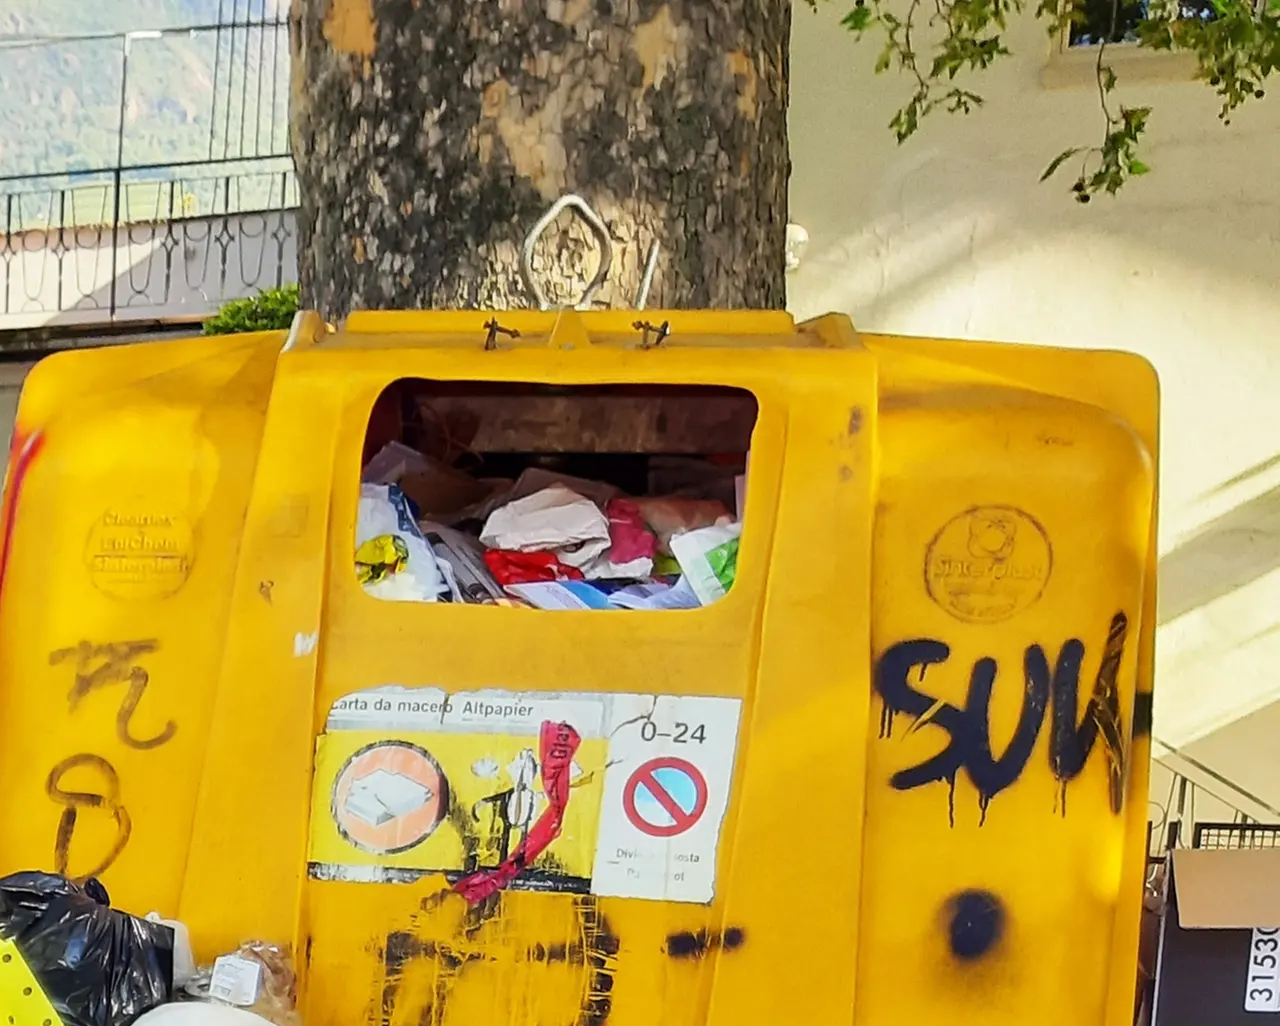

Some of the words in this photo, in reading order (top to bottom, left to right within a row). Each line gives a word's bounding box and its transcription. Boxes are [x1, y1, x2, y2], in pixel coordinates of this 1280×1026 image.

[374, 697, 391, 711] da
[397, 700, 454, 714] macero
[462, 700, 535, 718] Altpapier
